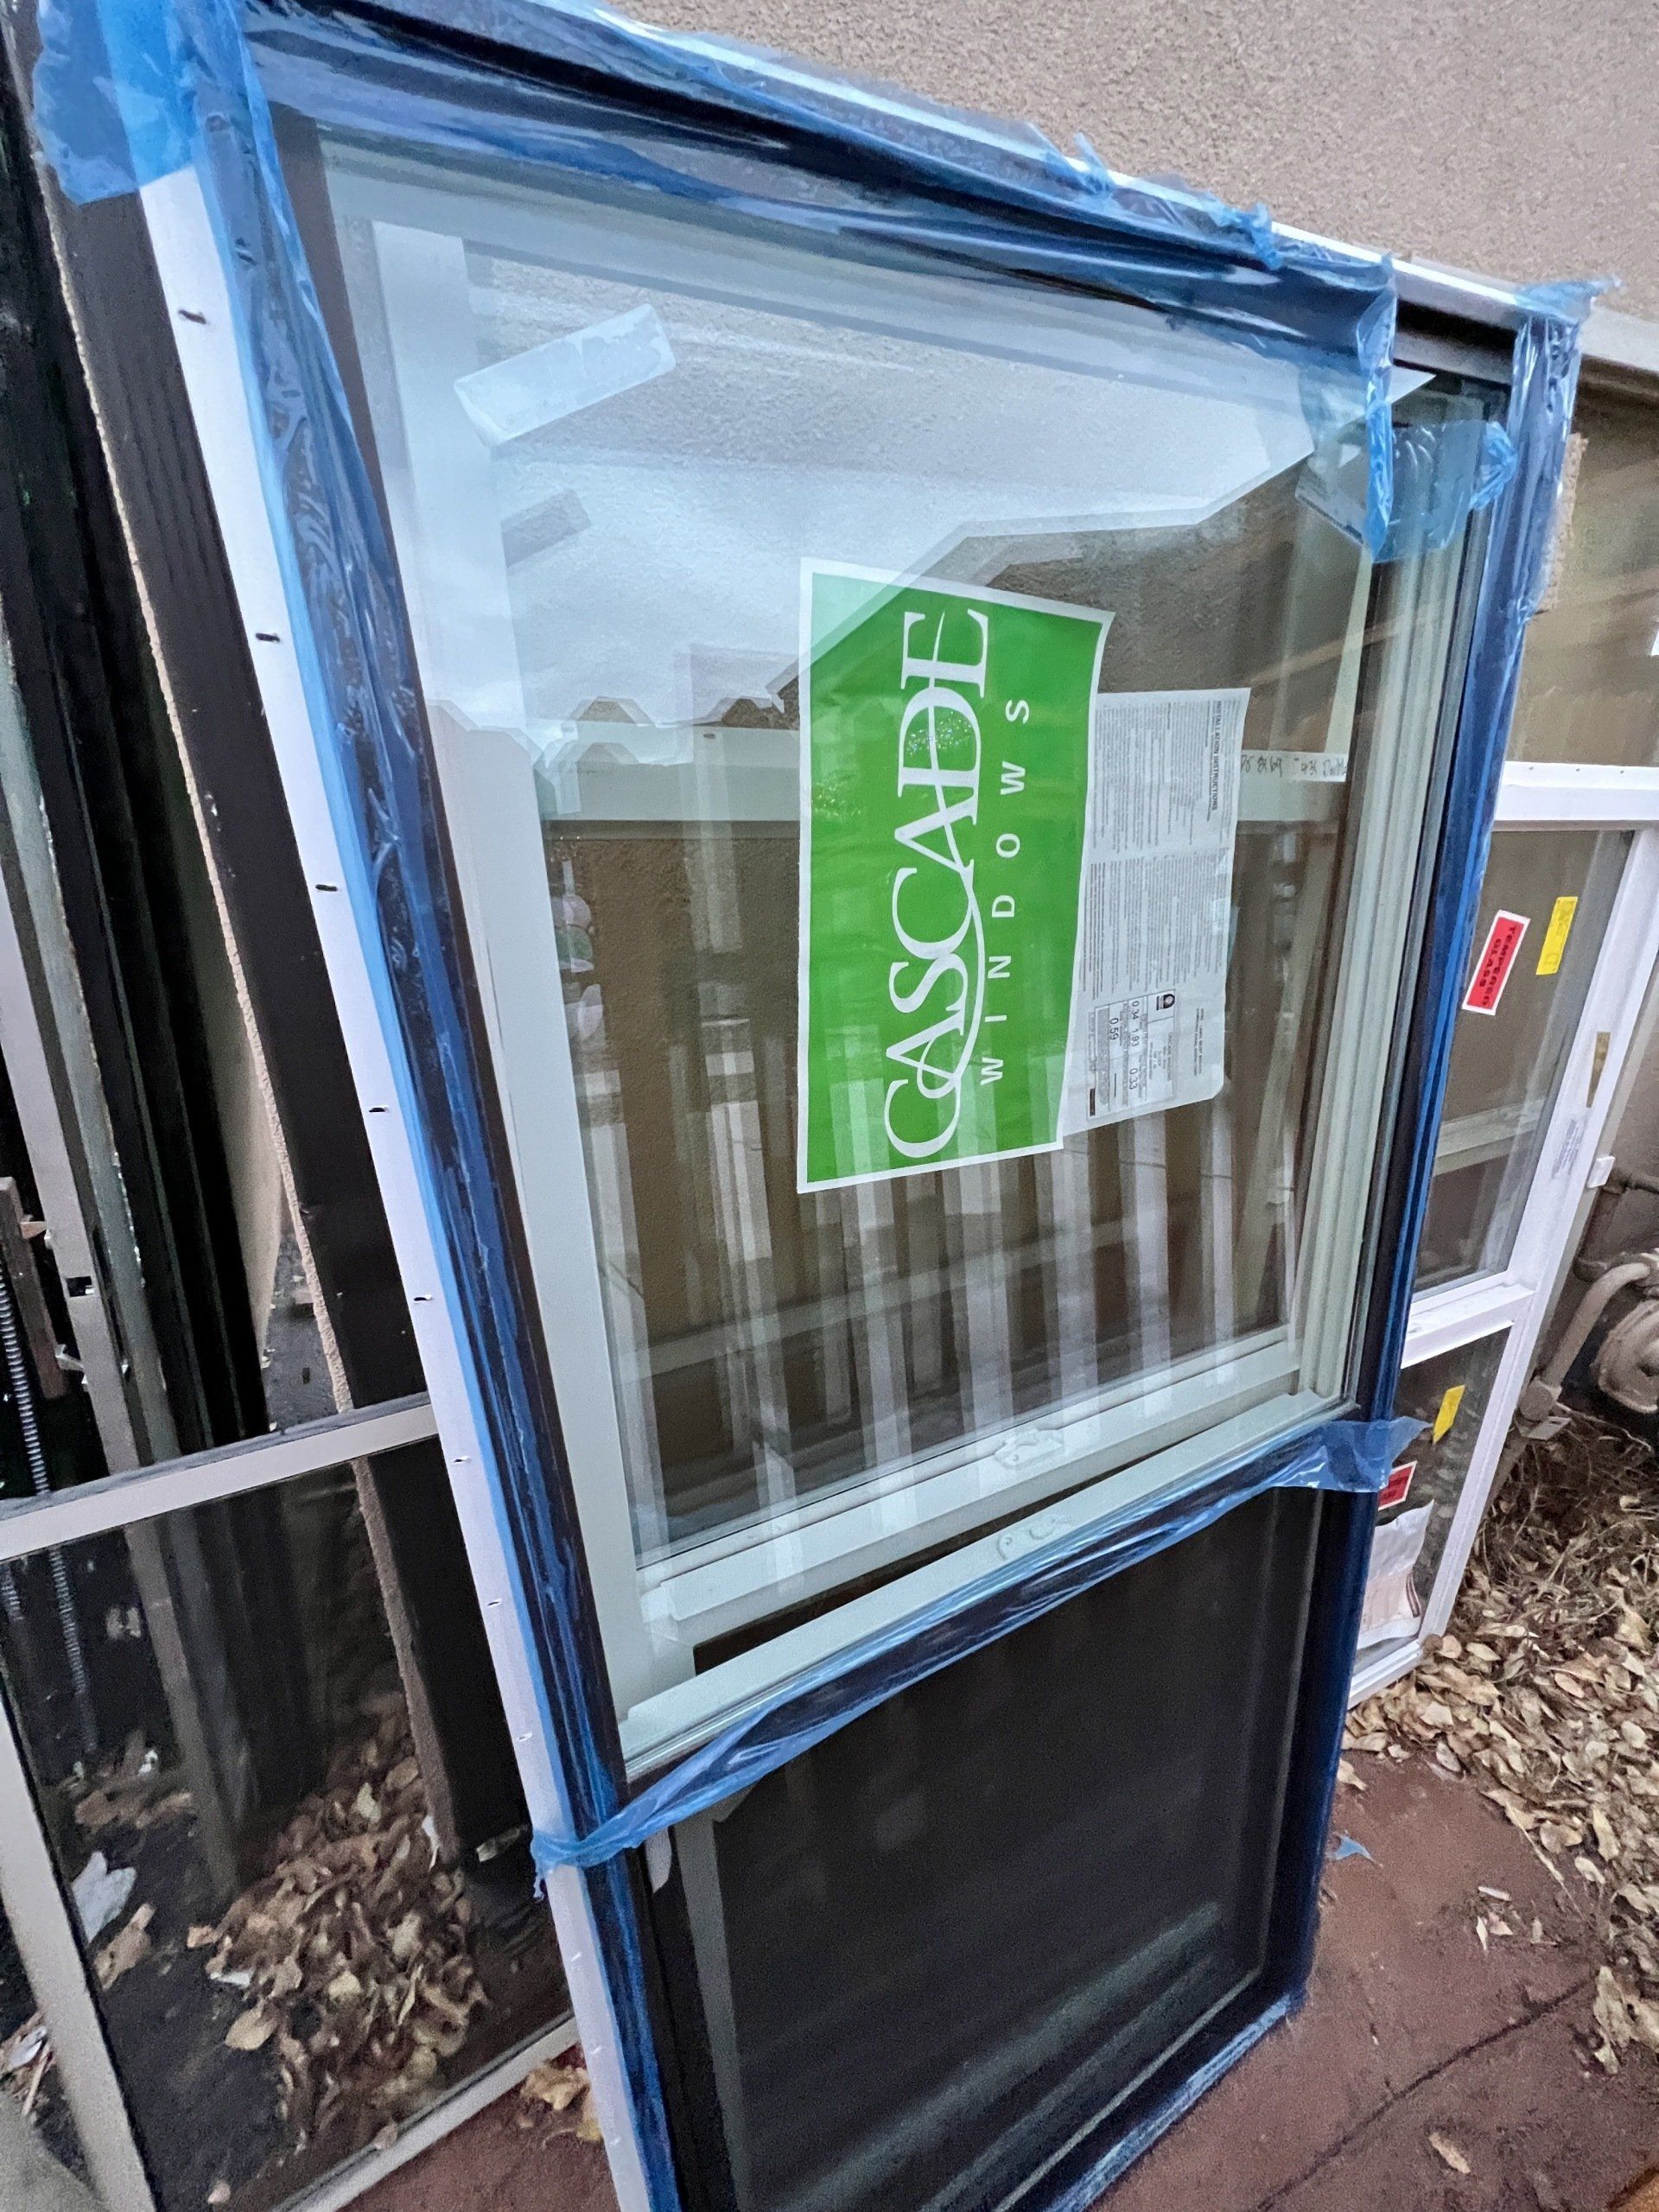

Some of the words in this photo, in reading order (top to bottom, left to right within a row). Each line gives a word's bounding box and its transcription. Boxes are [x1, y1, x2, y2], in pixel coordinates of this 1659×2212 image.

[884, 609, 989, 1159] CASCADE
[981, 699, 1030, 1086] WINDOWS
[1479, 938, 1503, 988] GLASS
[1482, 925, 1517, 1006] TEMPERED
[1109, 1017, 1120, 1040] 0.59
[1131, 1001, 1140, 1020] 0.34
[1131, 1028, 1140, 1047] 1.93
[1128, 1067, 1139, 1090] 0.33
